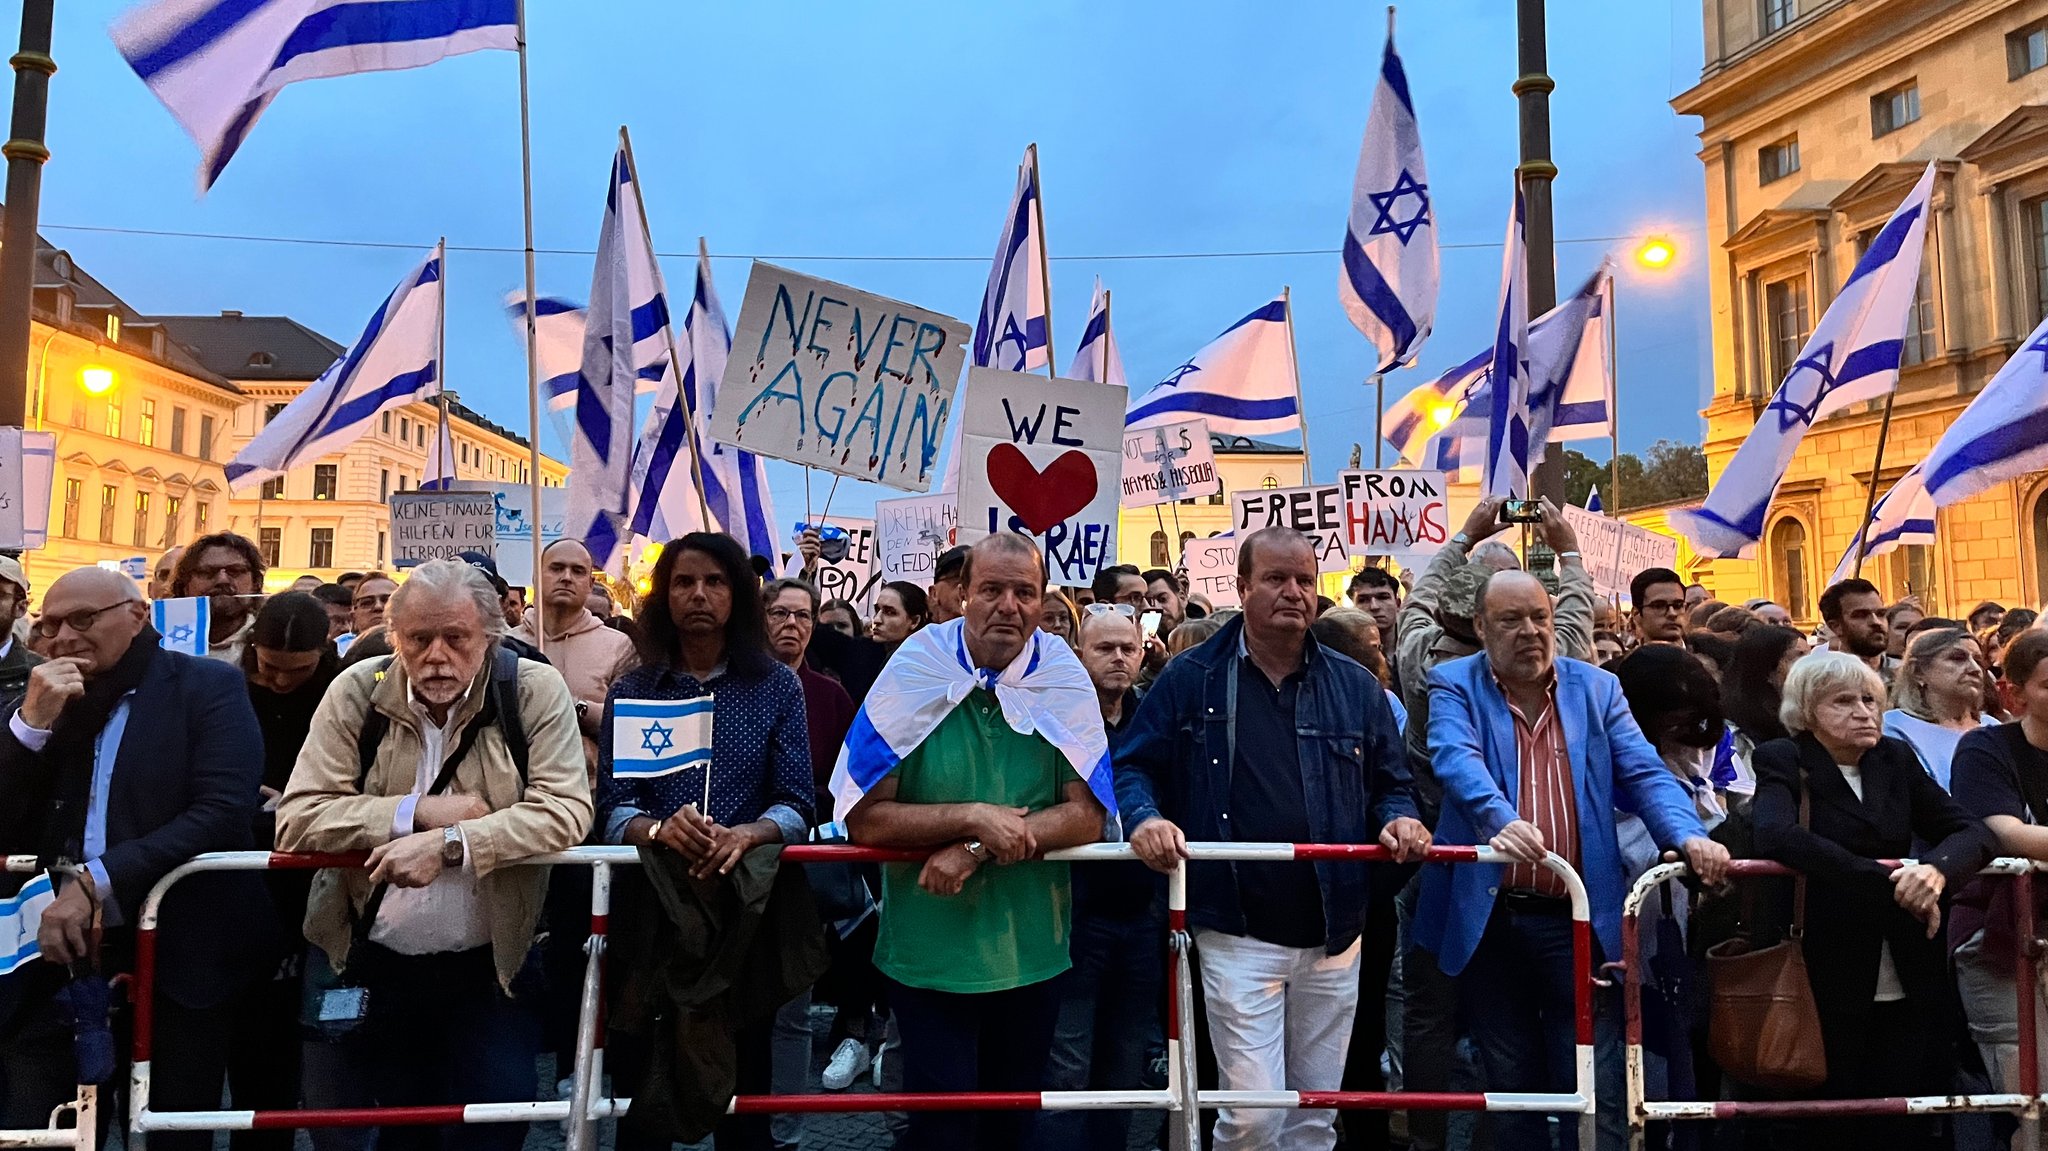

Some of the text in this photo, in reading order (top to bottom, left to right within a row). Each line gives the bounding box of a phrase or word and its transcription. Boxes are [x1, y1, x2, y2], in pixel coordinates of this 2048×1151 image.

[757, 284, 947, 392] NEVER
[738, 360, 948, 482] AGAIN
[1002, 398, 1084, 447] WE
[1155, 451, 1176, 465] FOR
[1122, 472, 1158, 496] HAMAS
[1344, 474, 1438, 501] FROM
[393, 501, 495, 520] KEINE FINANZ-
[883, 503, 958, 537] DREHT HA
[1241, 488, 1341, 532] FREE
[400, 521, 455, 540] HILFEN
[1347, 501, 1446, 547] HAMAS
[1568, 512, 1616, 544] FREEDOM
[887, 538, 912, 551] DEN
[1200, 547, 1236, 568] STO
[1307, 532, 1347, 562] ZA
[886, 550, 939, 575] GELDH
[1196, 574, 1237, 594] TER
